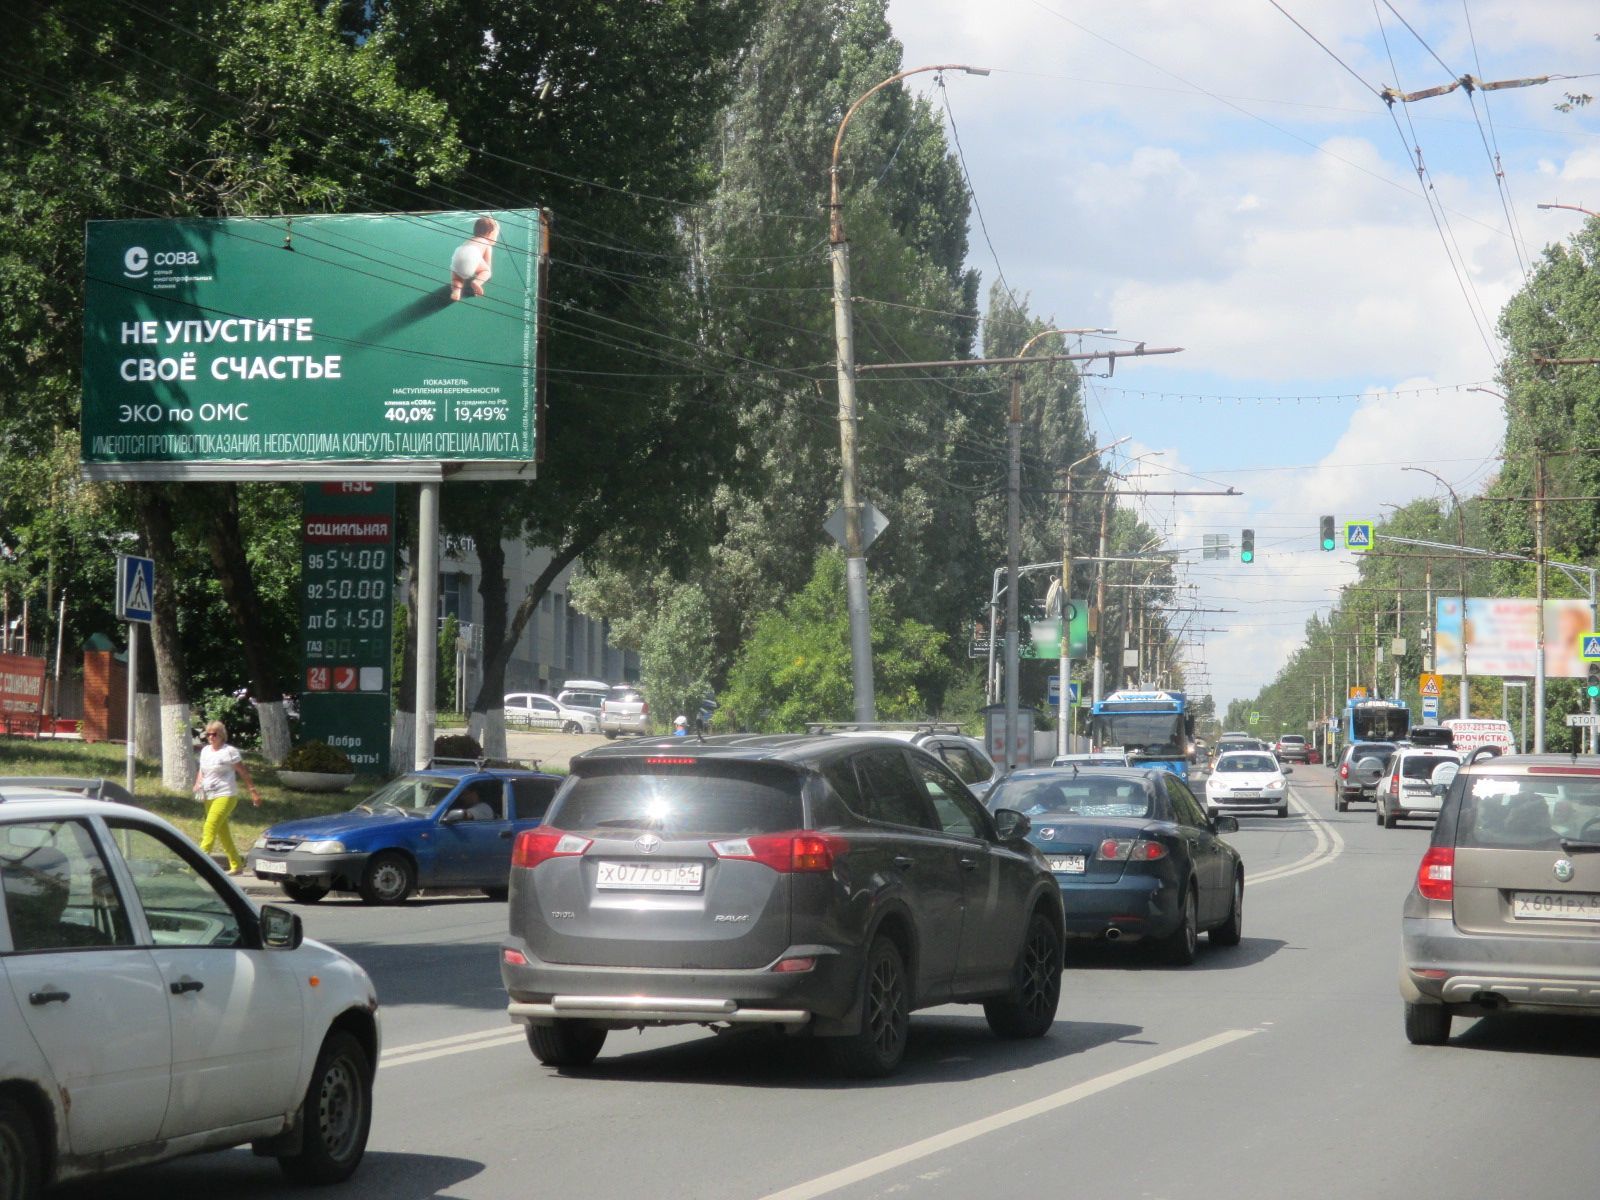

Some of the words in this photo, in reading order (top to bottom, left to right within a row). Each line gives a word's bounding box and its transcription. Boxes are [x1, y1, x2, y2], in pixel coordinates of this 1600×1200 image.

[121, 321, 158, 344] НЕ
[165, 318, 313, 343] УПУСТИТЕ
[120, 351, 197, 381] СВОЁ
[211, 355, 342, 380] СЧАСТЬЕ
[392, 387, 442, 395] НАСТУПЛЕНИЯ
[119, 404, 162, 422] ЭКО
[169, 408, 193, 422] по
[199, 403, 249, 421] ОМС
[92, 435, 145, 454] ИМЕЮТСЯ
[264, 433, 340, 454] НЕОБХОДИМА
[342, 432, 433, 454] КОНСУЛЬТАЦИЯ
[435, 432, 519, 454] СПЕЦИАЛИСТА
[307, 523, 388, 536] СОЦИАЛЬНАЯ
[308, 554, 324, 569] 95
[327, 550, 385, 570] 54.00
[308, 584, 323, 599] 92
[326, 580, 385, 599] 50.00
[307, 615, 322, 629] ДТ
[307, 640, 322, 652] ГАЗ
[311, 667, 326, 683] 24
[1571, 716, 1596, 724] СТОП
[328, 735, 362, 748] Добро
[1453, 734, 1508, 742] ПРОЧИСТКА
[552, 911, 575, 919] TOYOTA
